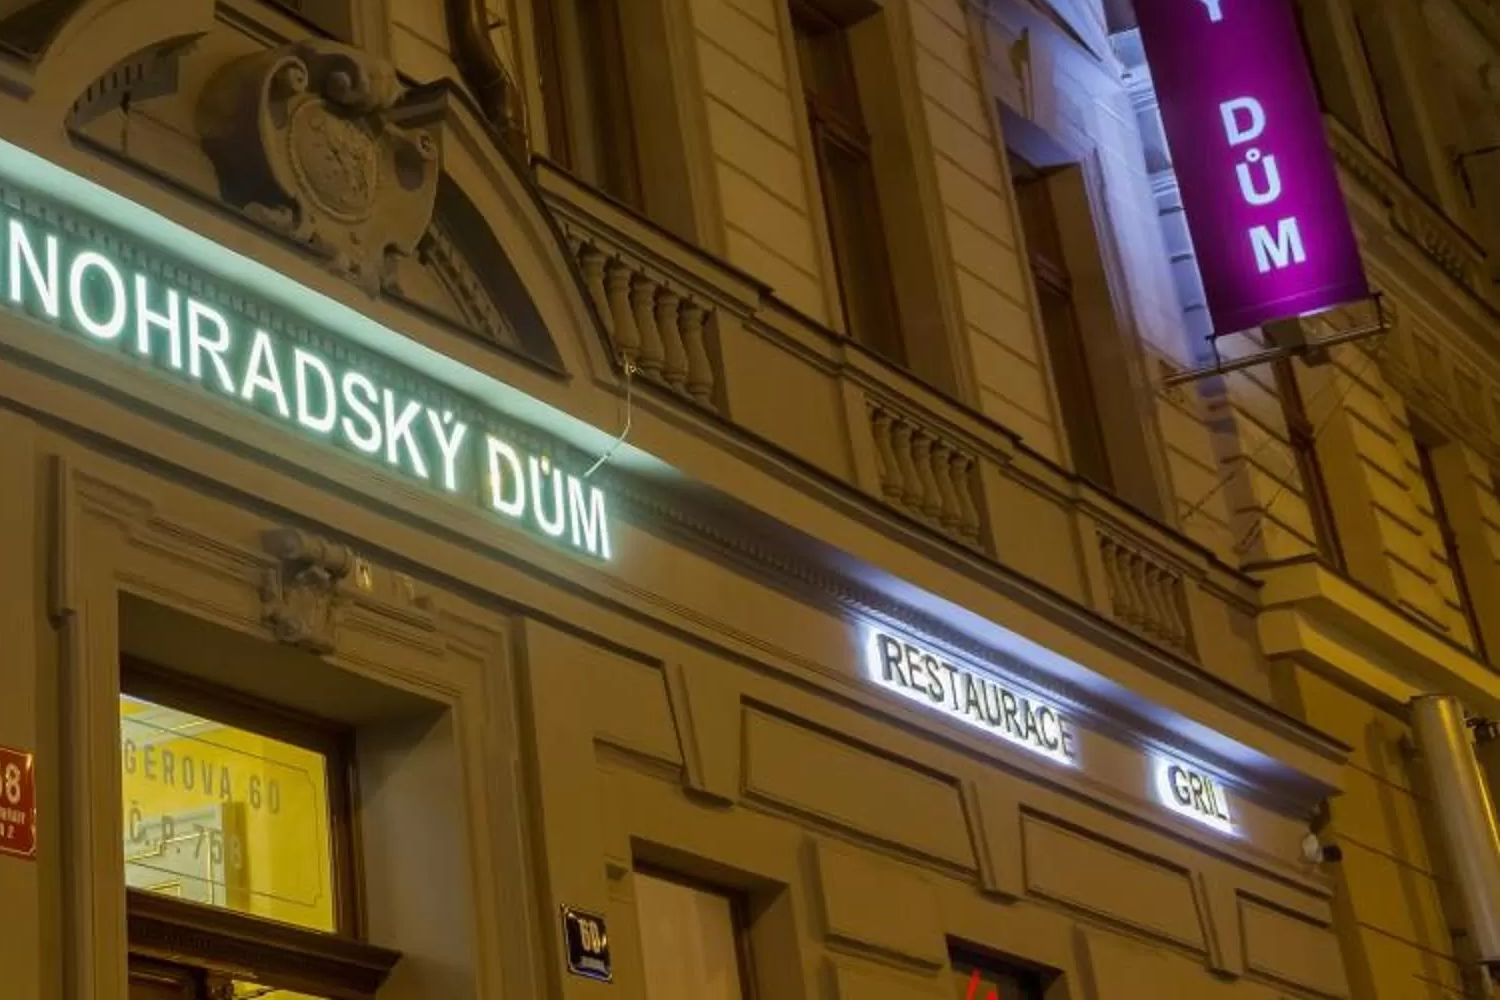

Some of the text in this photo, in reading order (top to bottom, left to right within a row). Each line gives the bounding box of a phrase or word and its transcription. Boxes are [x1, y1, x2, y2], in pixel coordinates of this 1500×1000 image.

[1218, 95, 1307, 273] DŮM
[485, 434, 614, 561] DŮM
[877, 633, 1078, 760] RESTAURACE
[249, 775, 281, 815] 60
